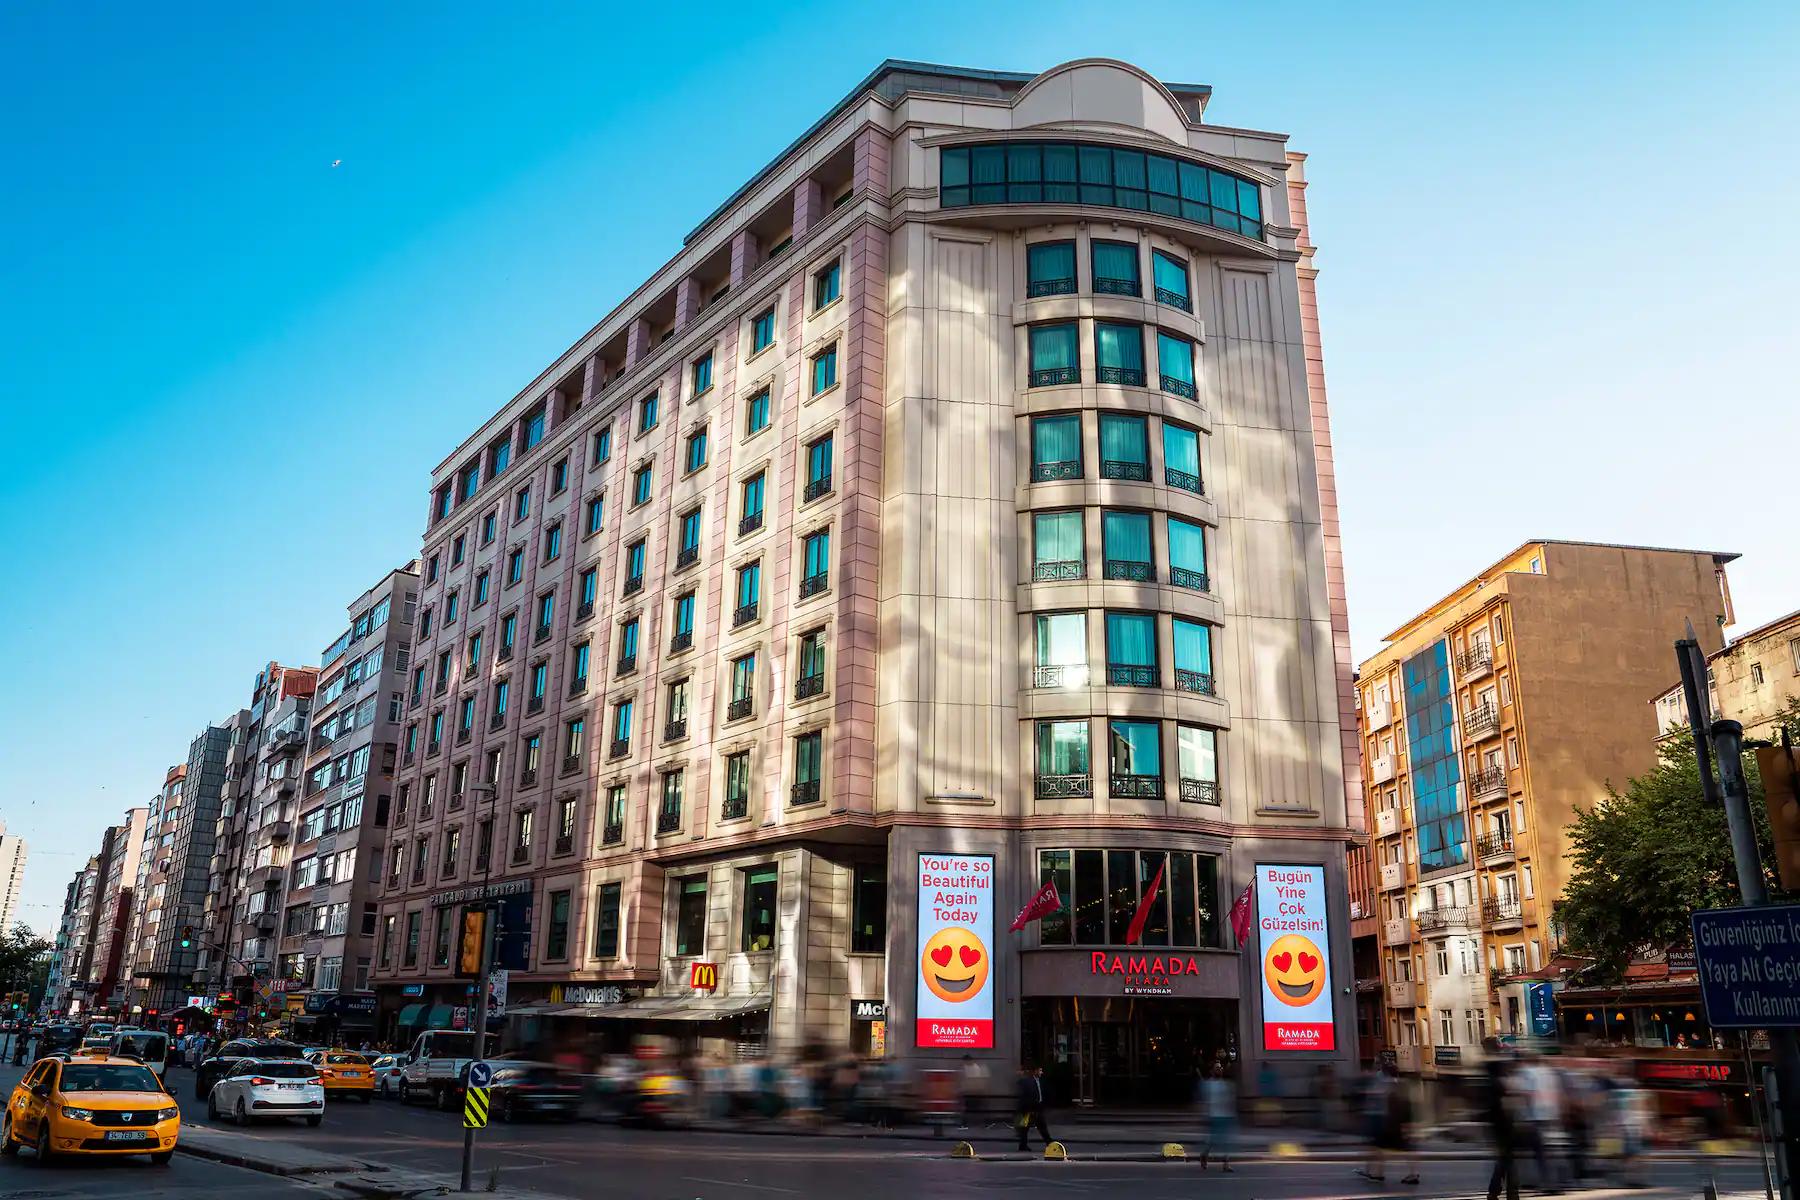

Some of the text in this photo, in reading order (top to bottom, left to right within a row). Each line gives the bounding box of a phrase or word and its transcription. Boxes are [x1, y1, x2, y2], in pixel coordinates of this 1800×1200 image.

[921, 857, 990, 873] You're so
[922, 874, 989, 889] Beautiful
[1268, 870, 1312, 885] Bugün
[933, 891, 978, 907] Again
[1275, 886, 1306, 899] Yine
[933, 908, 979, 924] Today
[1279, 901, 1306, 916] Çok
[1261, 917, 1324, 931] Güzelsin!
[1700, 918, 1788, 951] Güvenliğiniz
[1091, 951, 1200, 975] RAMADA
[1703, 957, 1738, 989] Yaya
[1741, 955, 1762, 982] Alt
[1125, 976, 1170, 985] PLAZA
[564, 986, 621, 1003] McDonald's
[932, 1023, 978, 1036] RAMADA
[1277, 1027, 1320, 1039] RAMADA
